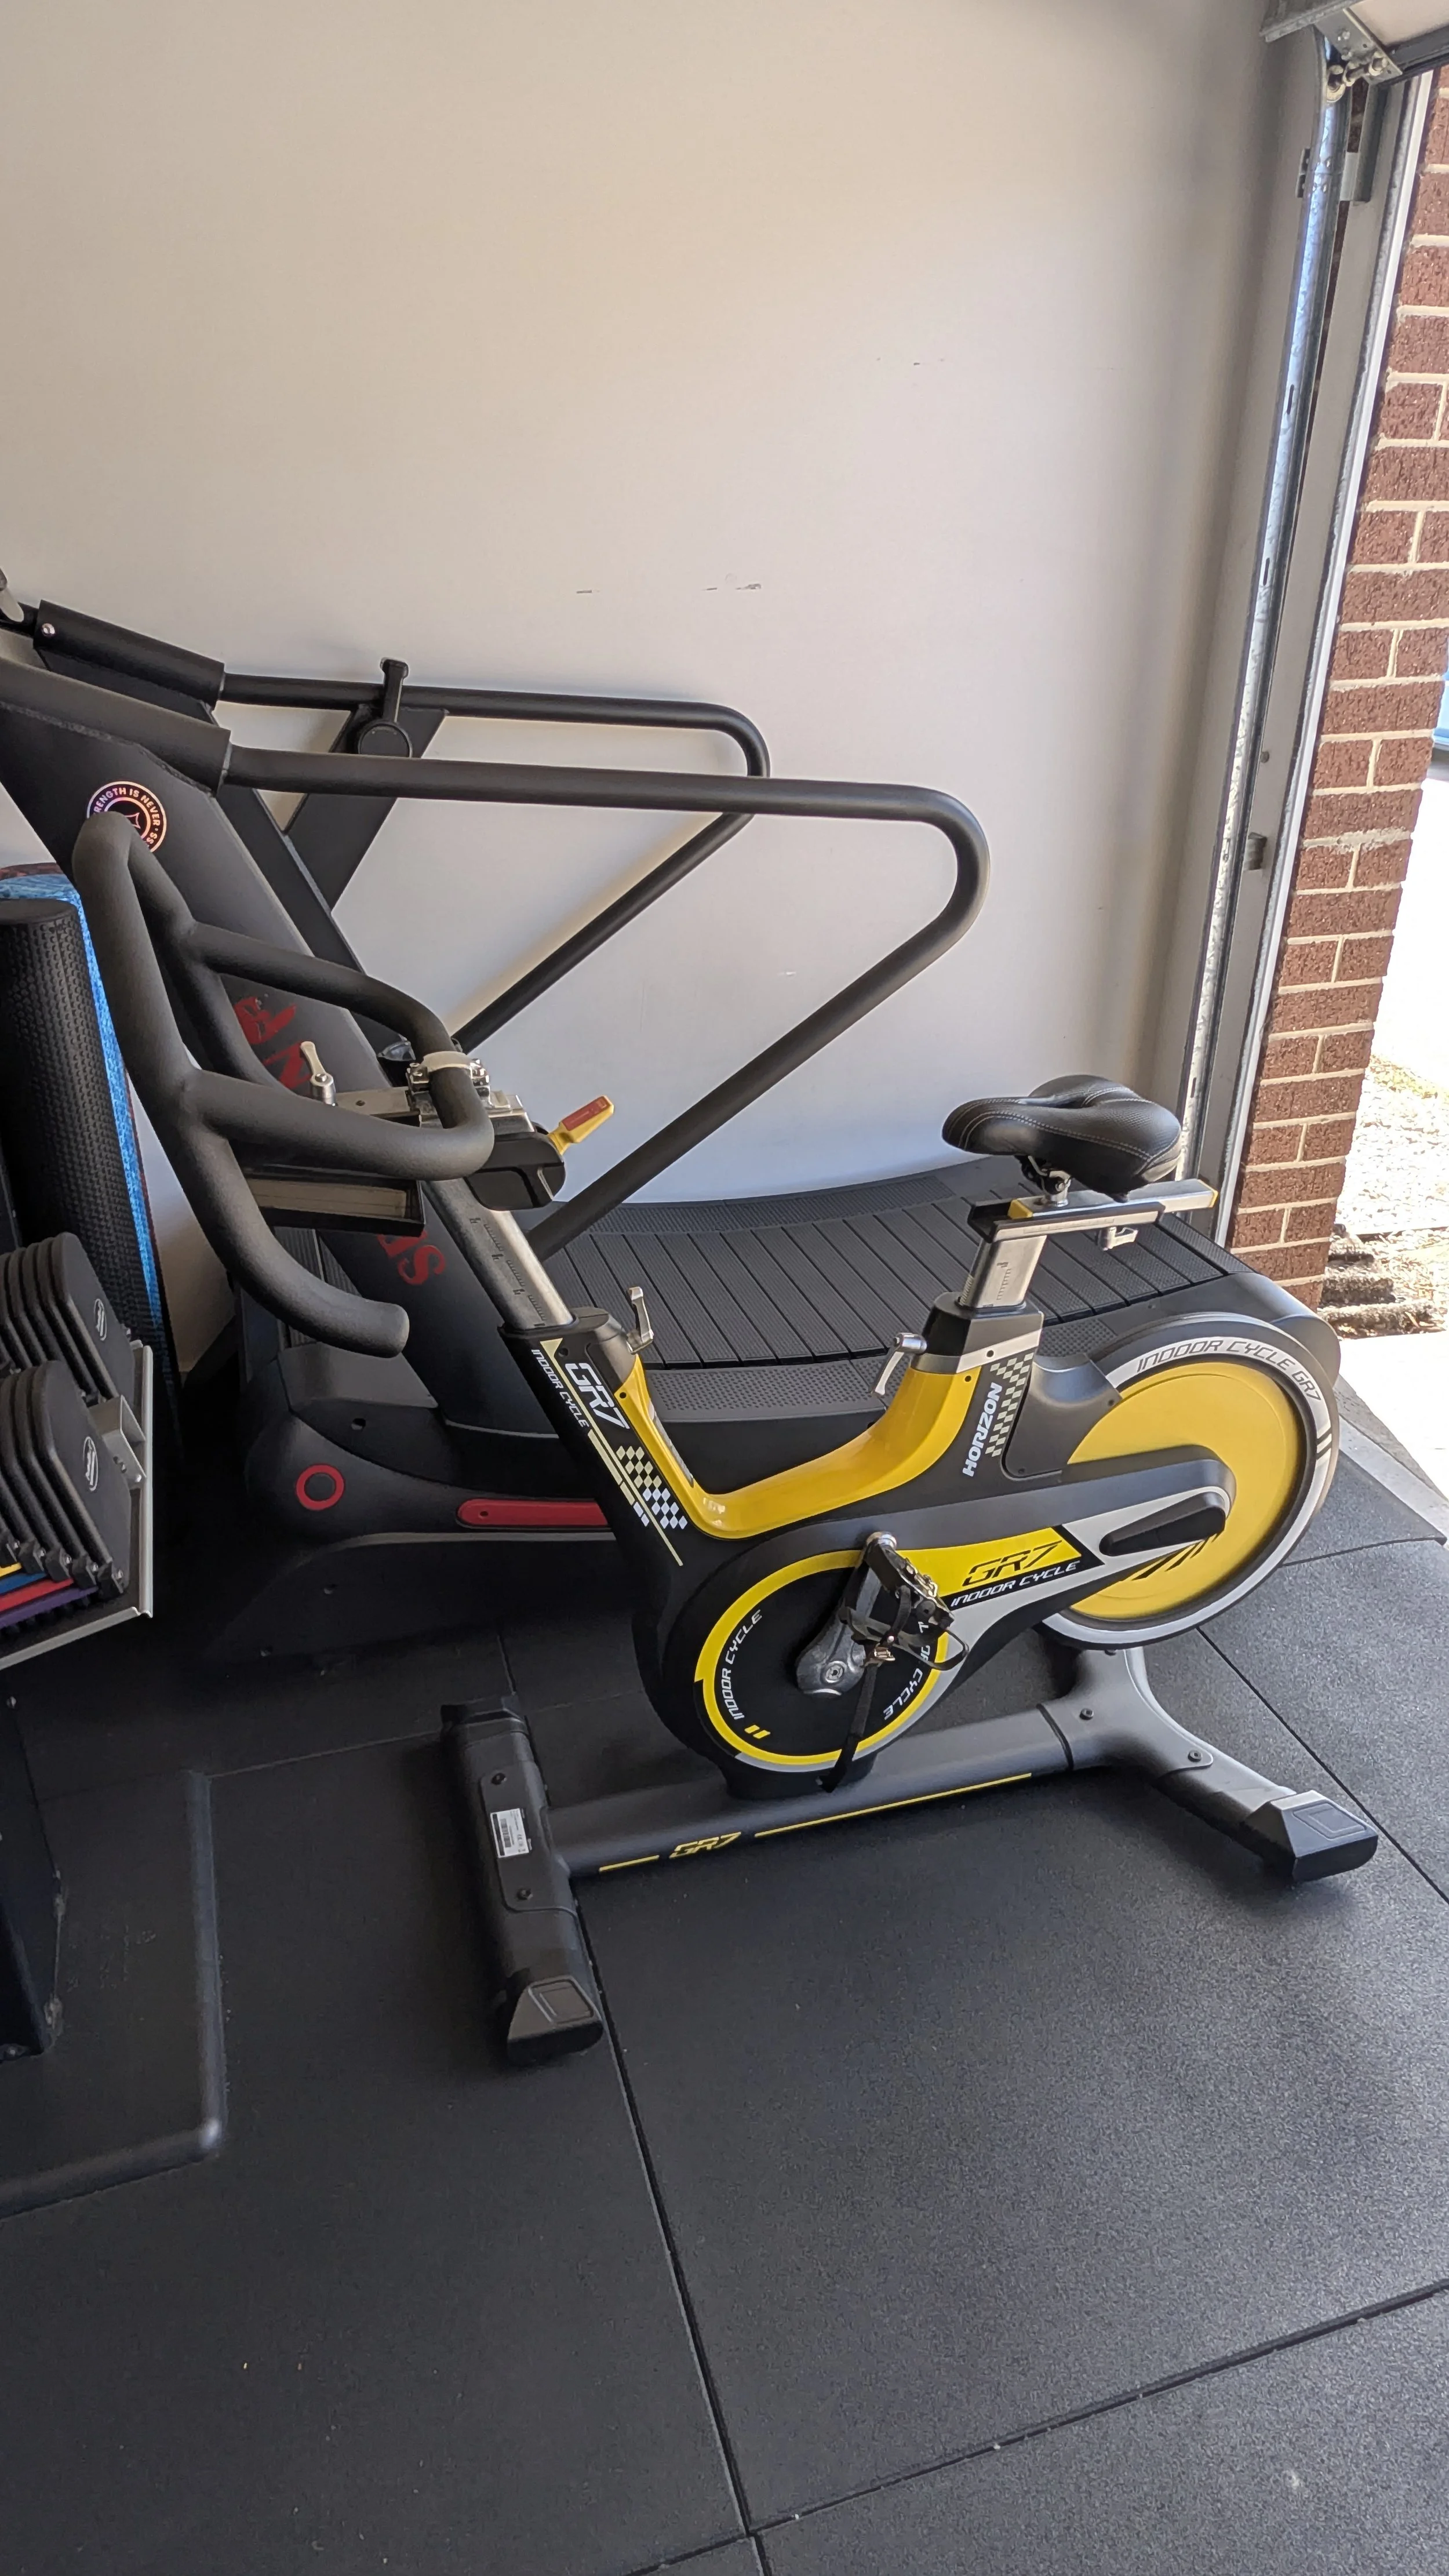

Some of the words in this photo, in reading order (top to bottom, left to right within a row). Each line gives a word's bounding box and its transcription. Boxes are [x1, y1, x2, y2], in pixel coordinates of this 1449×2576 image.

[93, 787, 126, 813] RENGTH
[129, 788, 140, 798] IS
[140, 795, 161, 826] NEVER
[531, 1349, 564, 1389] INDOOR
[559, 1391, 589, 1428] CYCLE
[565, 1363, 630, 1429] GR7
[1137, 1340, 1224, 1373] INDOOR
[1226, 1341, 1295, 1371] CYCLE
[1291, 1370, 1321, 1401] GR7
[962, 1382, 1003, 1477] HORIZON
[951, 1580, 1016, 1607] INDOOR
[1019, 1560, 1080, 1586] CYCLE
[962, 1540, 1062, 1587] GR7
[725, 1609, 762, 1664] CYCLE
[721, 1668, 745, 1720] INDOOR
[883, 1668, 923, 1720] CYCLE
[669, 1831, 742, 1859] GR7
